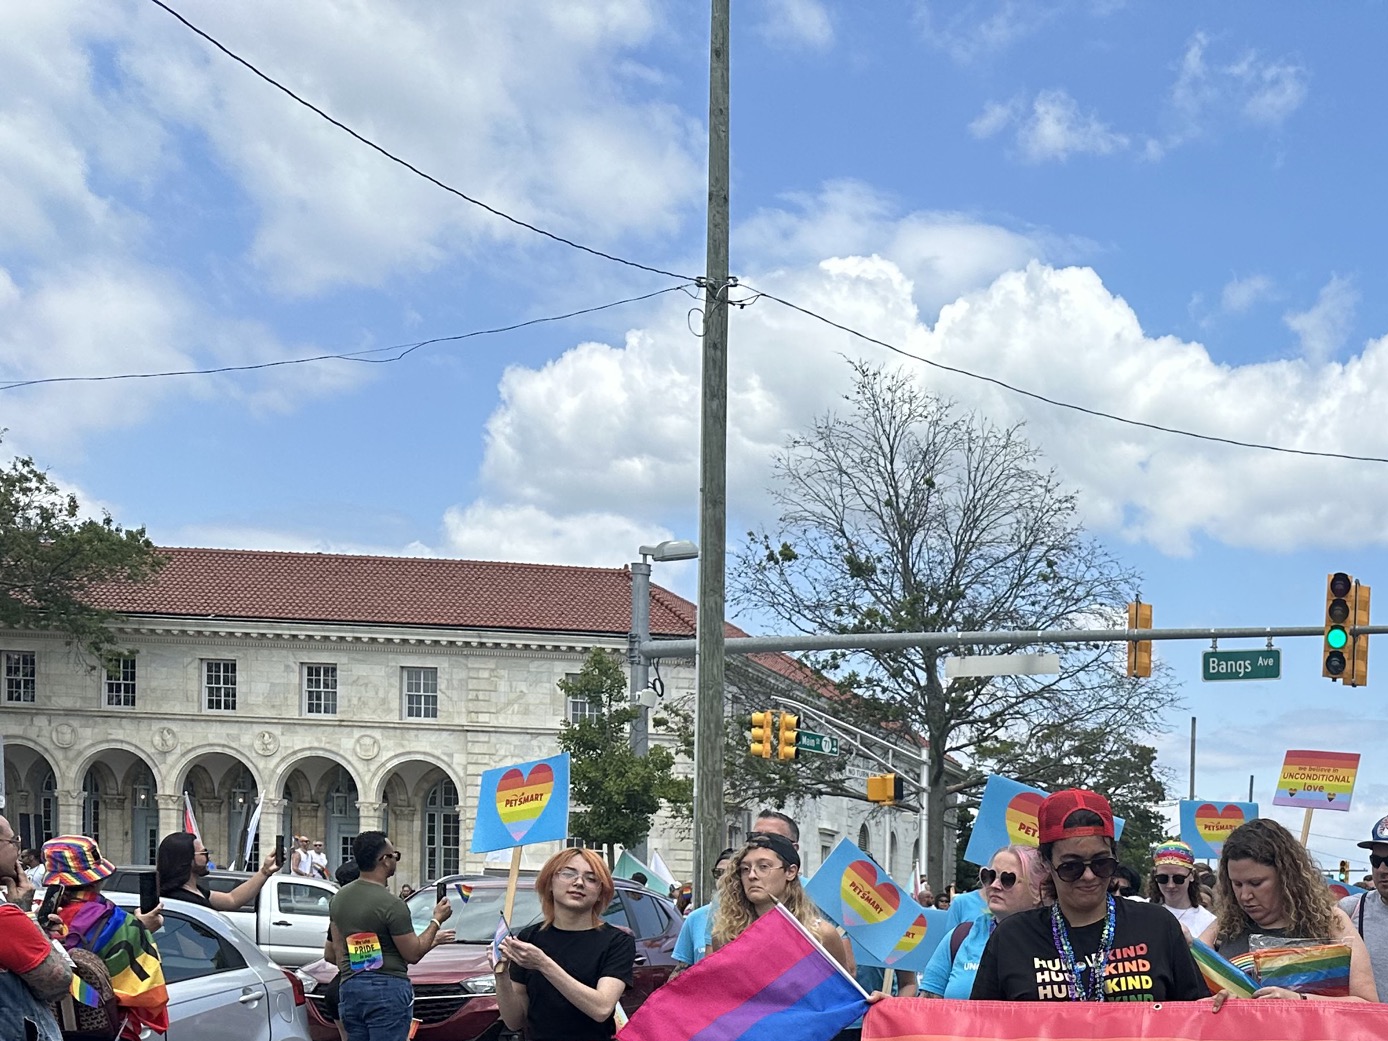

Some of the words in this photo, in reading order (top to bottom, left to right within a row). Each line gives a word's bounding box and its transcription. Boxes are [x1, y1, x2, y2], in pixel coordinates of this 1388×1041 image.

[1209, 657, 1252, 677] Bangs
[1257, 656, 1274, 666] Ave
[802, 735, 816, 747] Main
[824, 739, 831, 749] 71
[1282, 772, 1351, 783] UNCONDITIONAL
[1303, 782, 1325, 792] love
[849, 881, 884, 915] PETSMART
[354, 943, 375, 955] PRIDE
[1104, 959, 1152, 976] KIND
[1104, 975, 1153, 994] KIND
